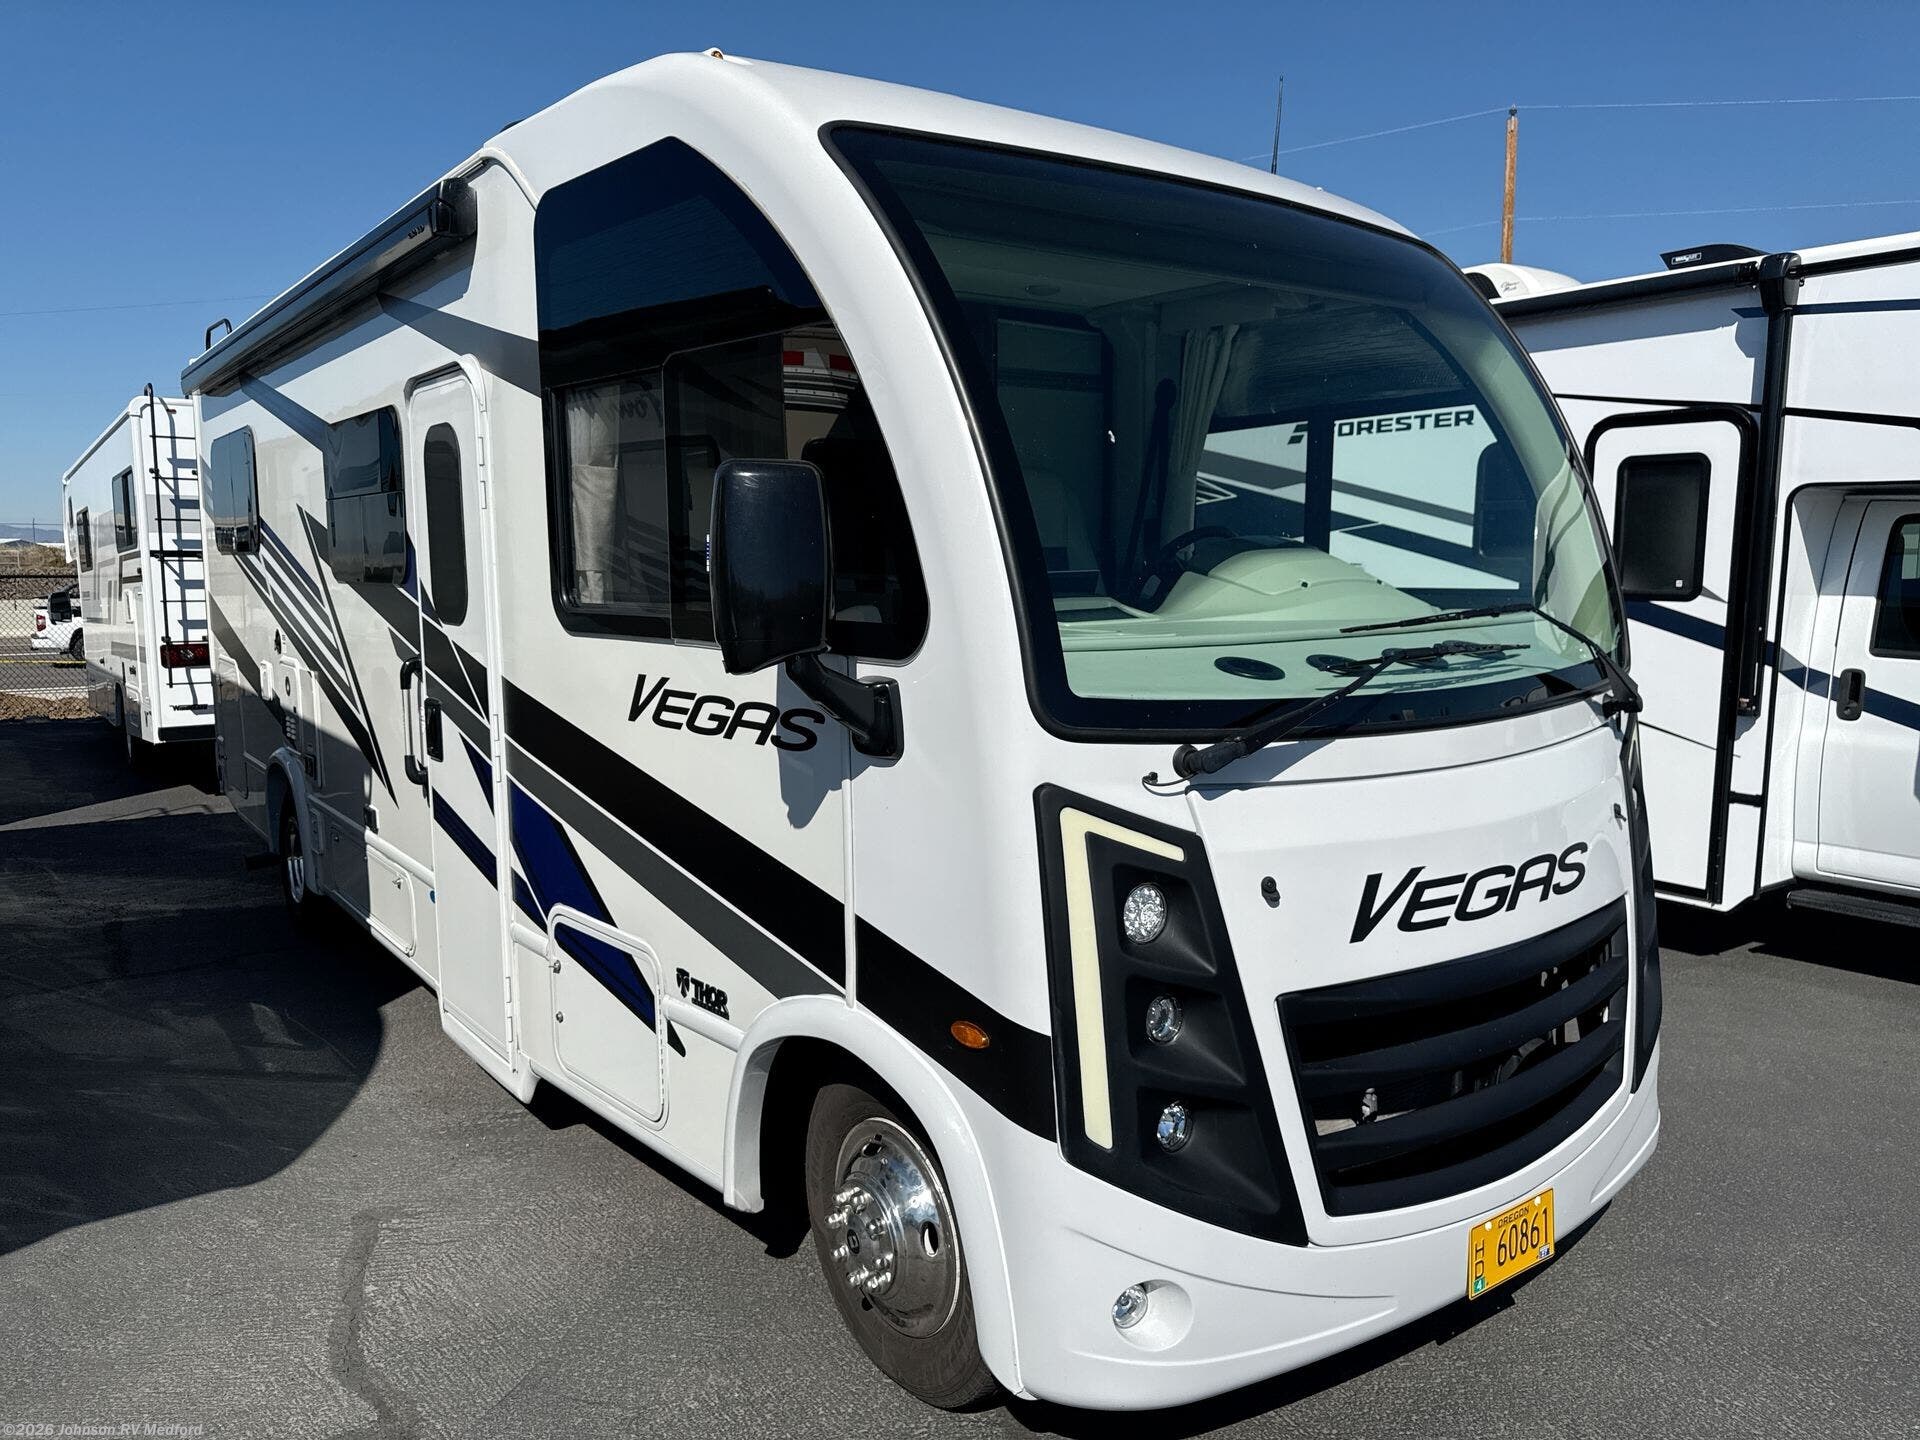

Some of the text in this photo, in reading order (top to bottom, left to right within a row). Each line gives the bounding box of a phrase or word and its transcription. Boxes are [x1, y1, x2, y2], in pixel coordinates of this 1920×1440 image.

[628, 674, 826, 752] VEGAS
[1349, 841, 1589, 944] VEGAS
[690, 977, 729, 1014] THOR
[1497, 1205, 1531, 1229] OREGON
[1497, 1206, 1549, 1267] 60861
